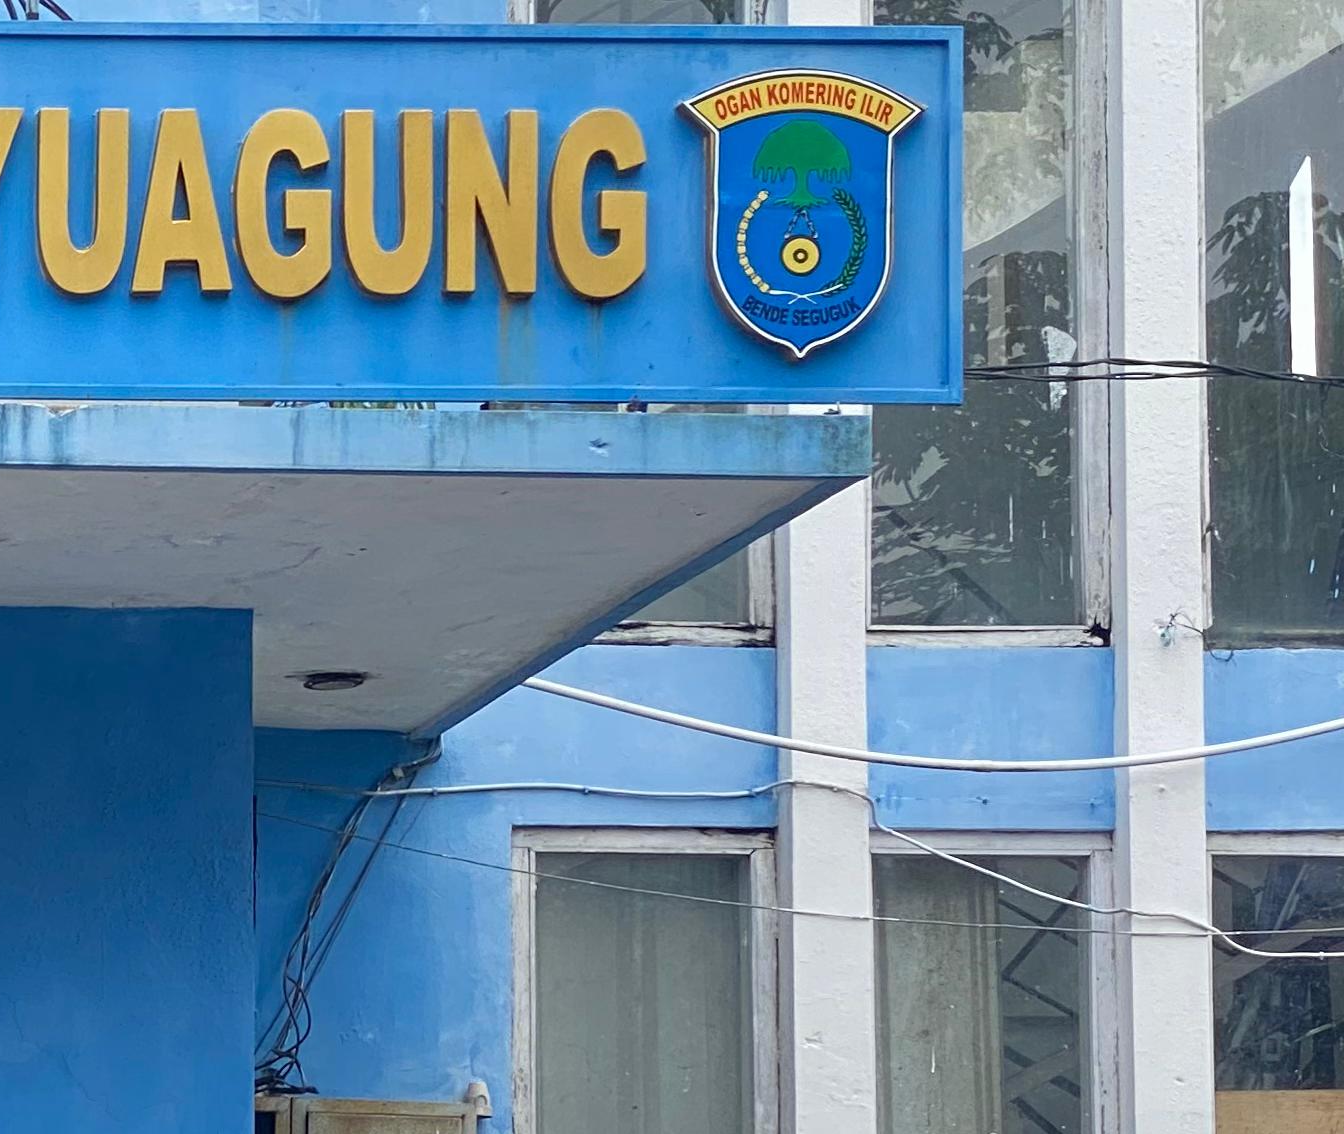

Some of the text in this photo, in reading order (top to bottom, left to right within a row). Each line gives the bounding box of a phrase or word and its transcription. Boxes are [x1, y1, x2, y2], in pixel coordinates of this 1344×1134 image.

[714, 81, 895, 125] OGAN KOMERING ILIR
[741, 295, 861, 327] BENDE SEGUGUK
